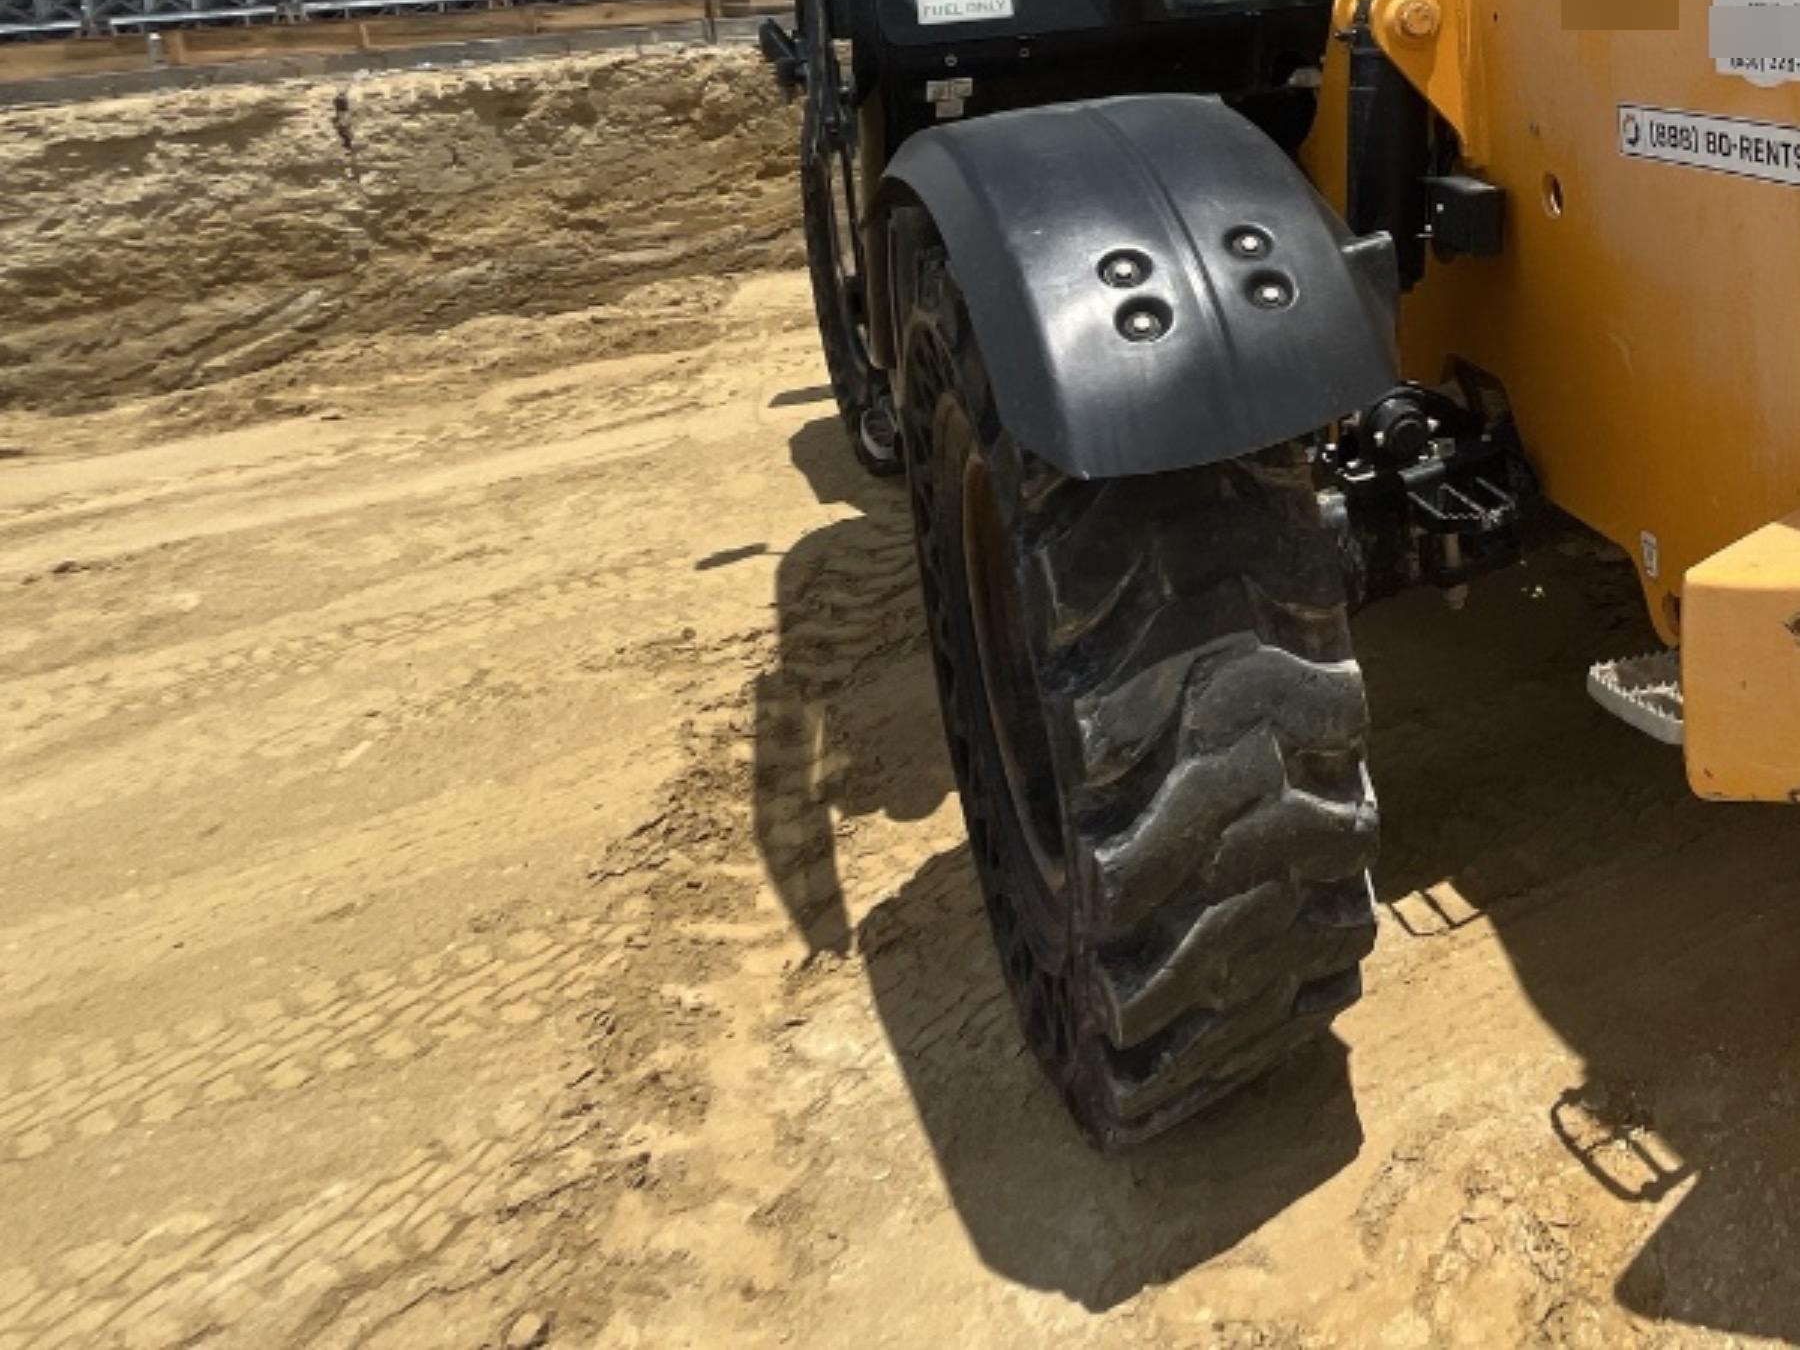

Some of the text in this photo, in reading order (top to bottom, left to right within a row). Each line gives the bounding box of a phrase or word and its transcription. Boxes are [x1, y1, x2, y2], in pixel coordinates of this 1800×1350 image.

[923, 0, 1006, 17] FUEL ONLY
[1649, 120, 1699, 154] (888)
